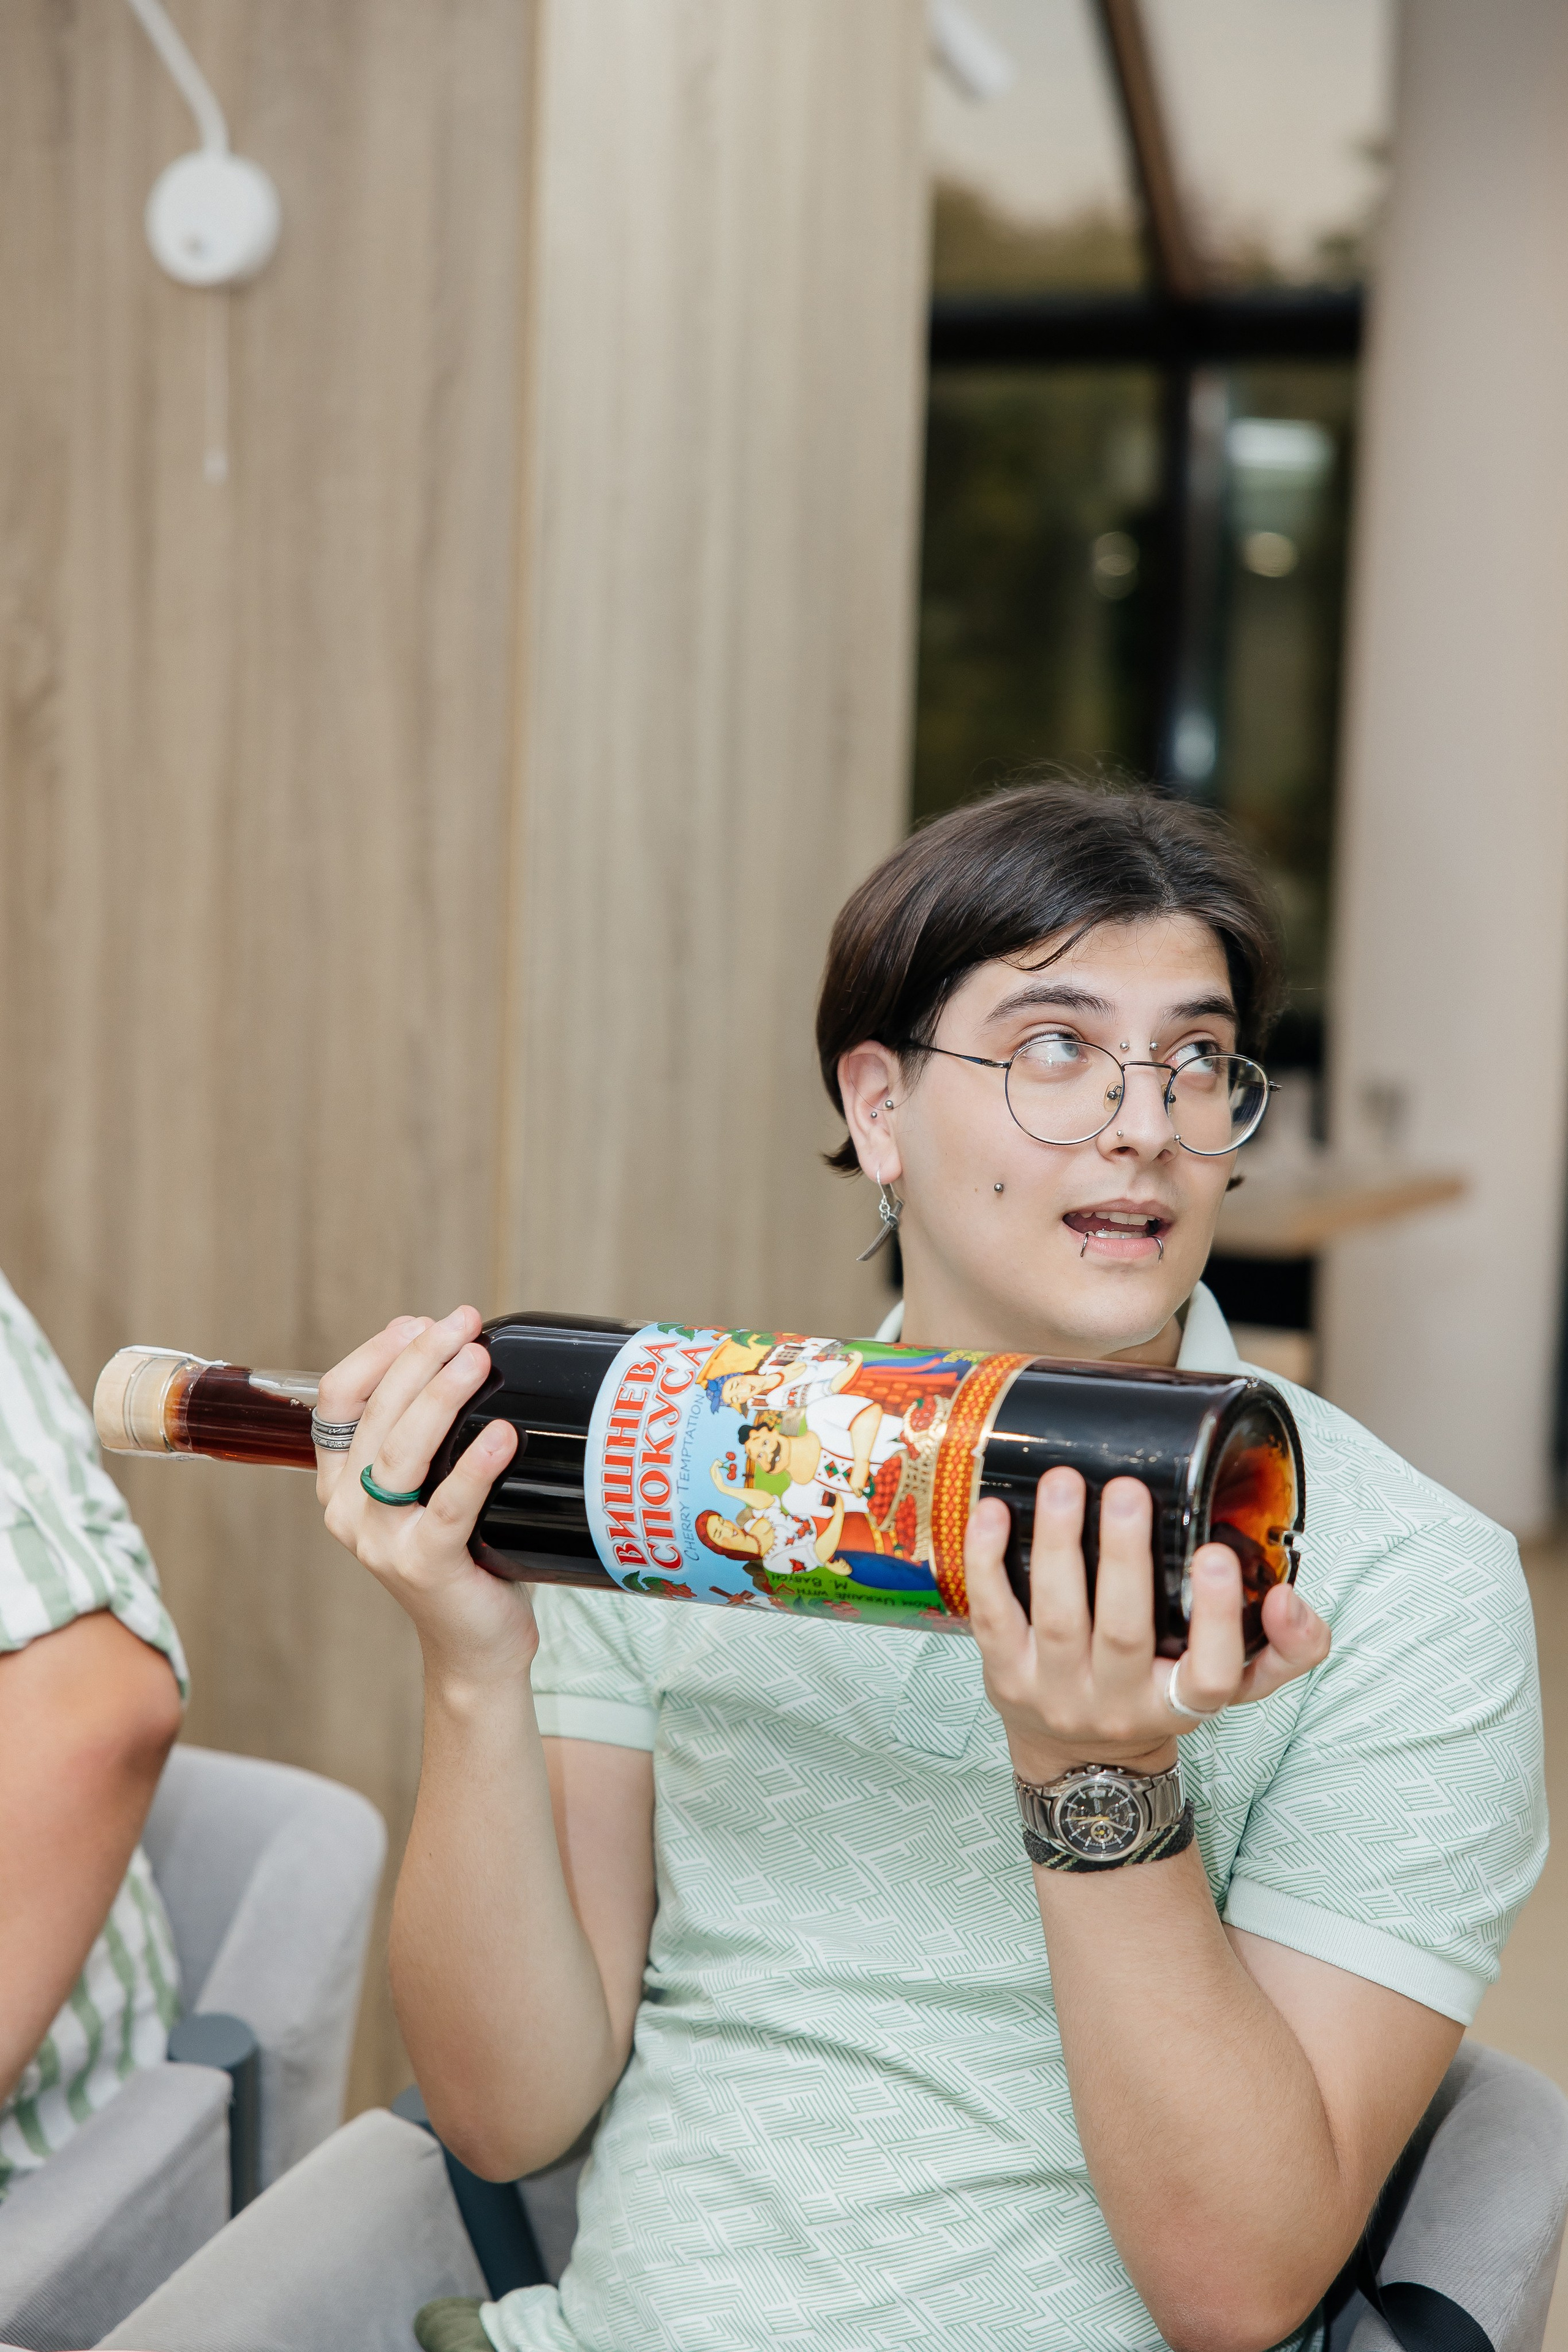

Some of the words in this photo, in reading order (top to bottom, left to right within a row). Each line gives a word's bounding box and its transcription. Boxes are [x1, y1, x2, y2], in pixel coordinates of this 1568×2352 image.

[602, 1340, 682, 1566] ВИШНЕВА
[638, 1344, 717, 1570] СПОКУСА
[676, 1393, 704, 1494] TEMPTATION
[679, 1501, 700, 1561] CHERRY
